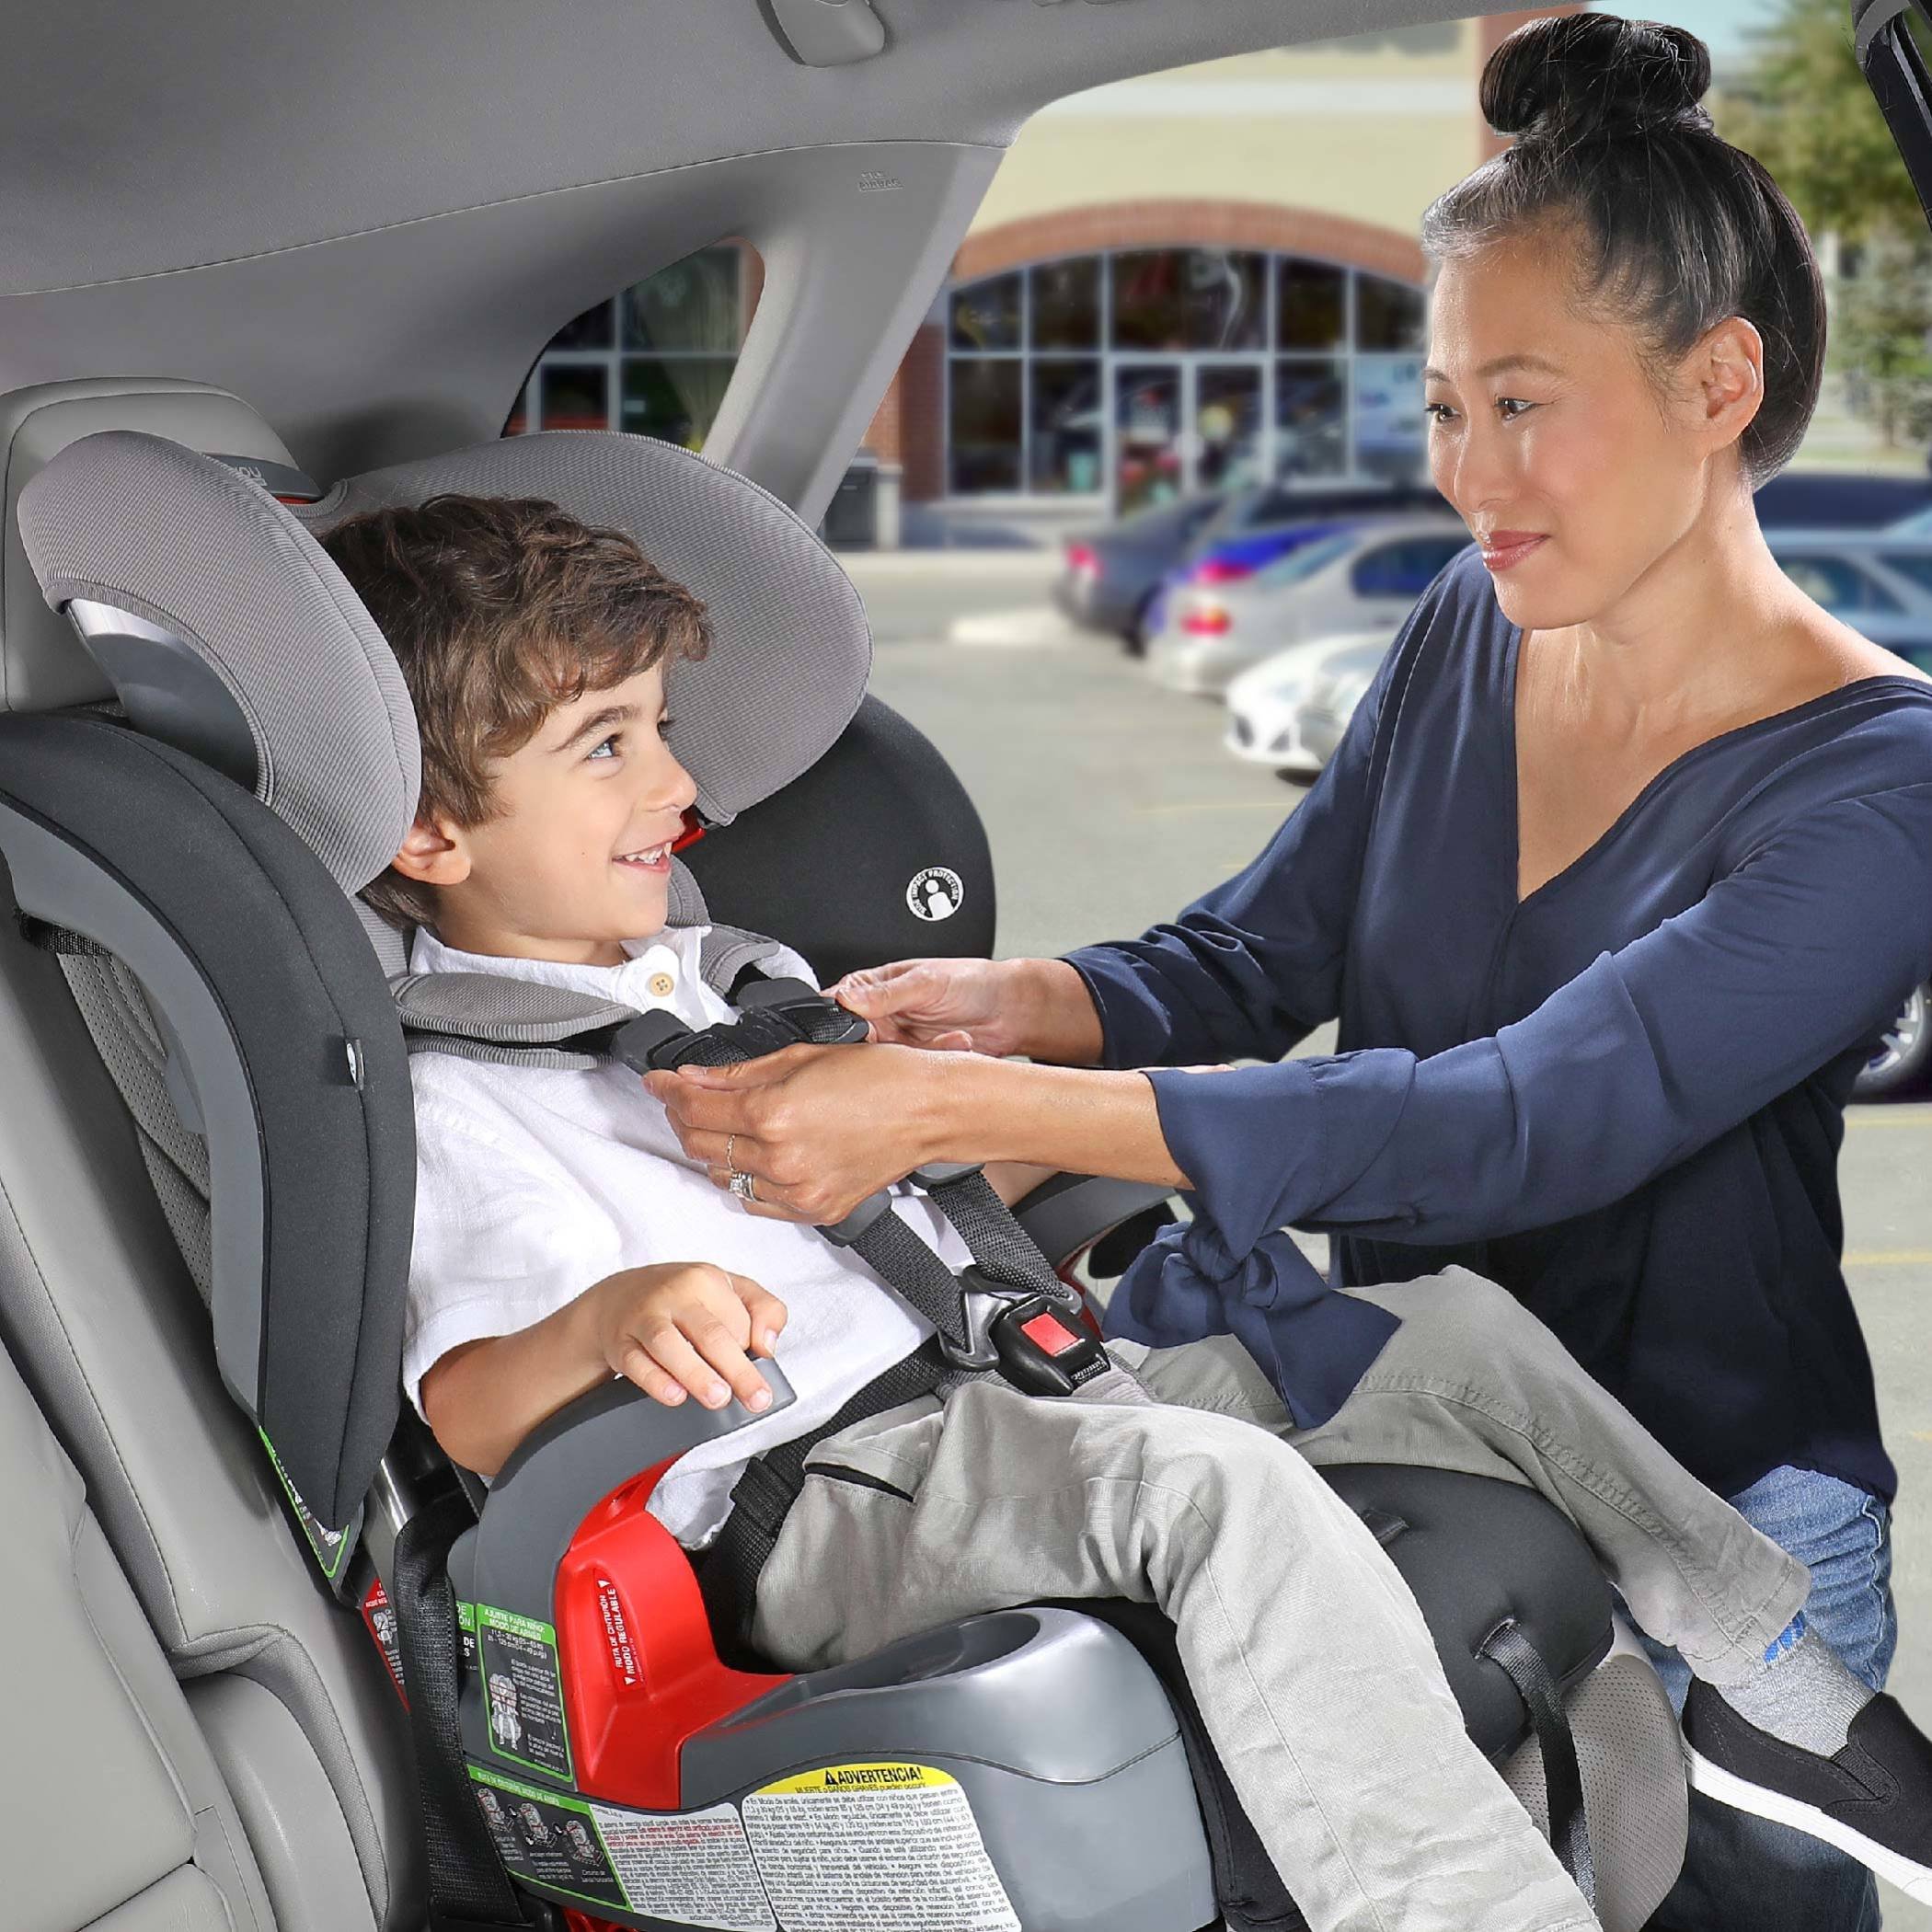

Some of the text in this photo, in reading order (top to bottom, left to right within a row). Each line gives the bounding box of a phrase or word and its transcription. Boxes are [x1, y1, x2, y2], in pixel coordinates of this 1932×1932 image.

[912, 872, 927, 898] IMPACT
[927, 869, 959, 900] PROTECTION
[489, 1617, 510, 1631] MODO
[607, 1588, 636, 1674] MODO REGULABLE
[464, 1637, 475, 1649] DE
[609, 1636, 618, 1647] DE
[613, 1647, 623, 1668] RUTA
[837, 1766, 924, 1785] ADVERTENCIA!
[852, 1784, 878, 1792] GRAVES
[880, 1783, 903, 1792] pueden
